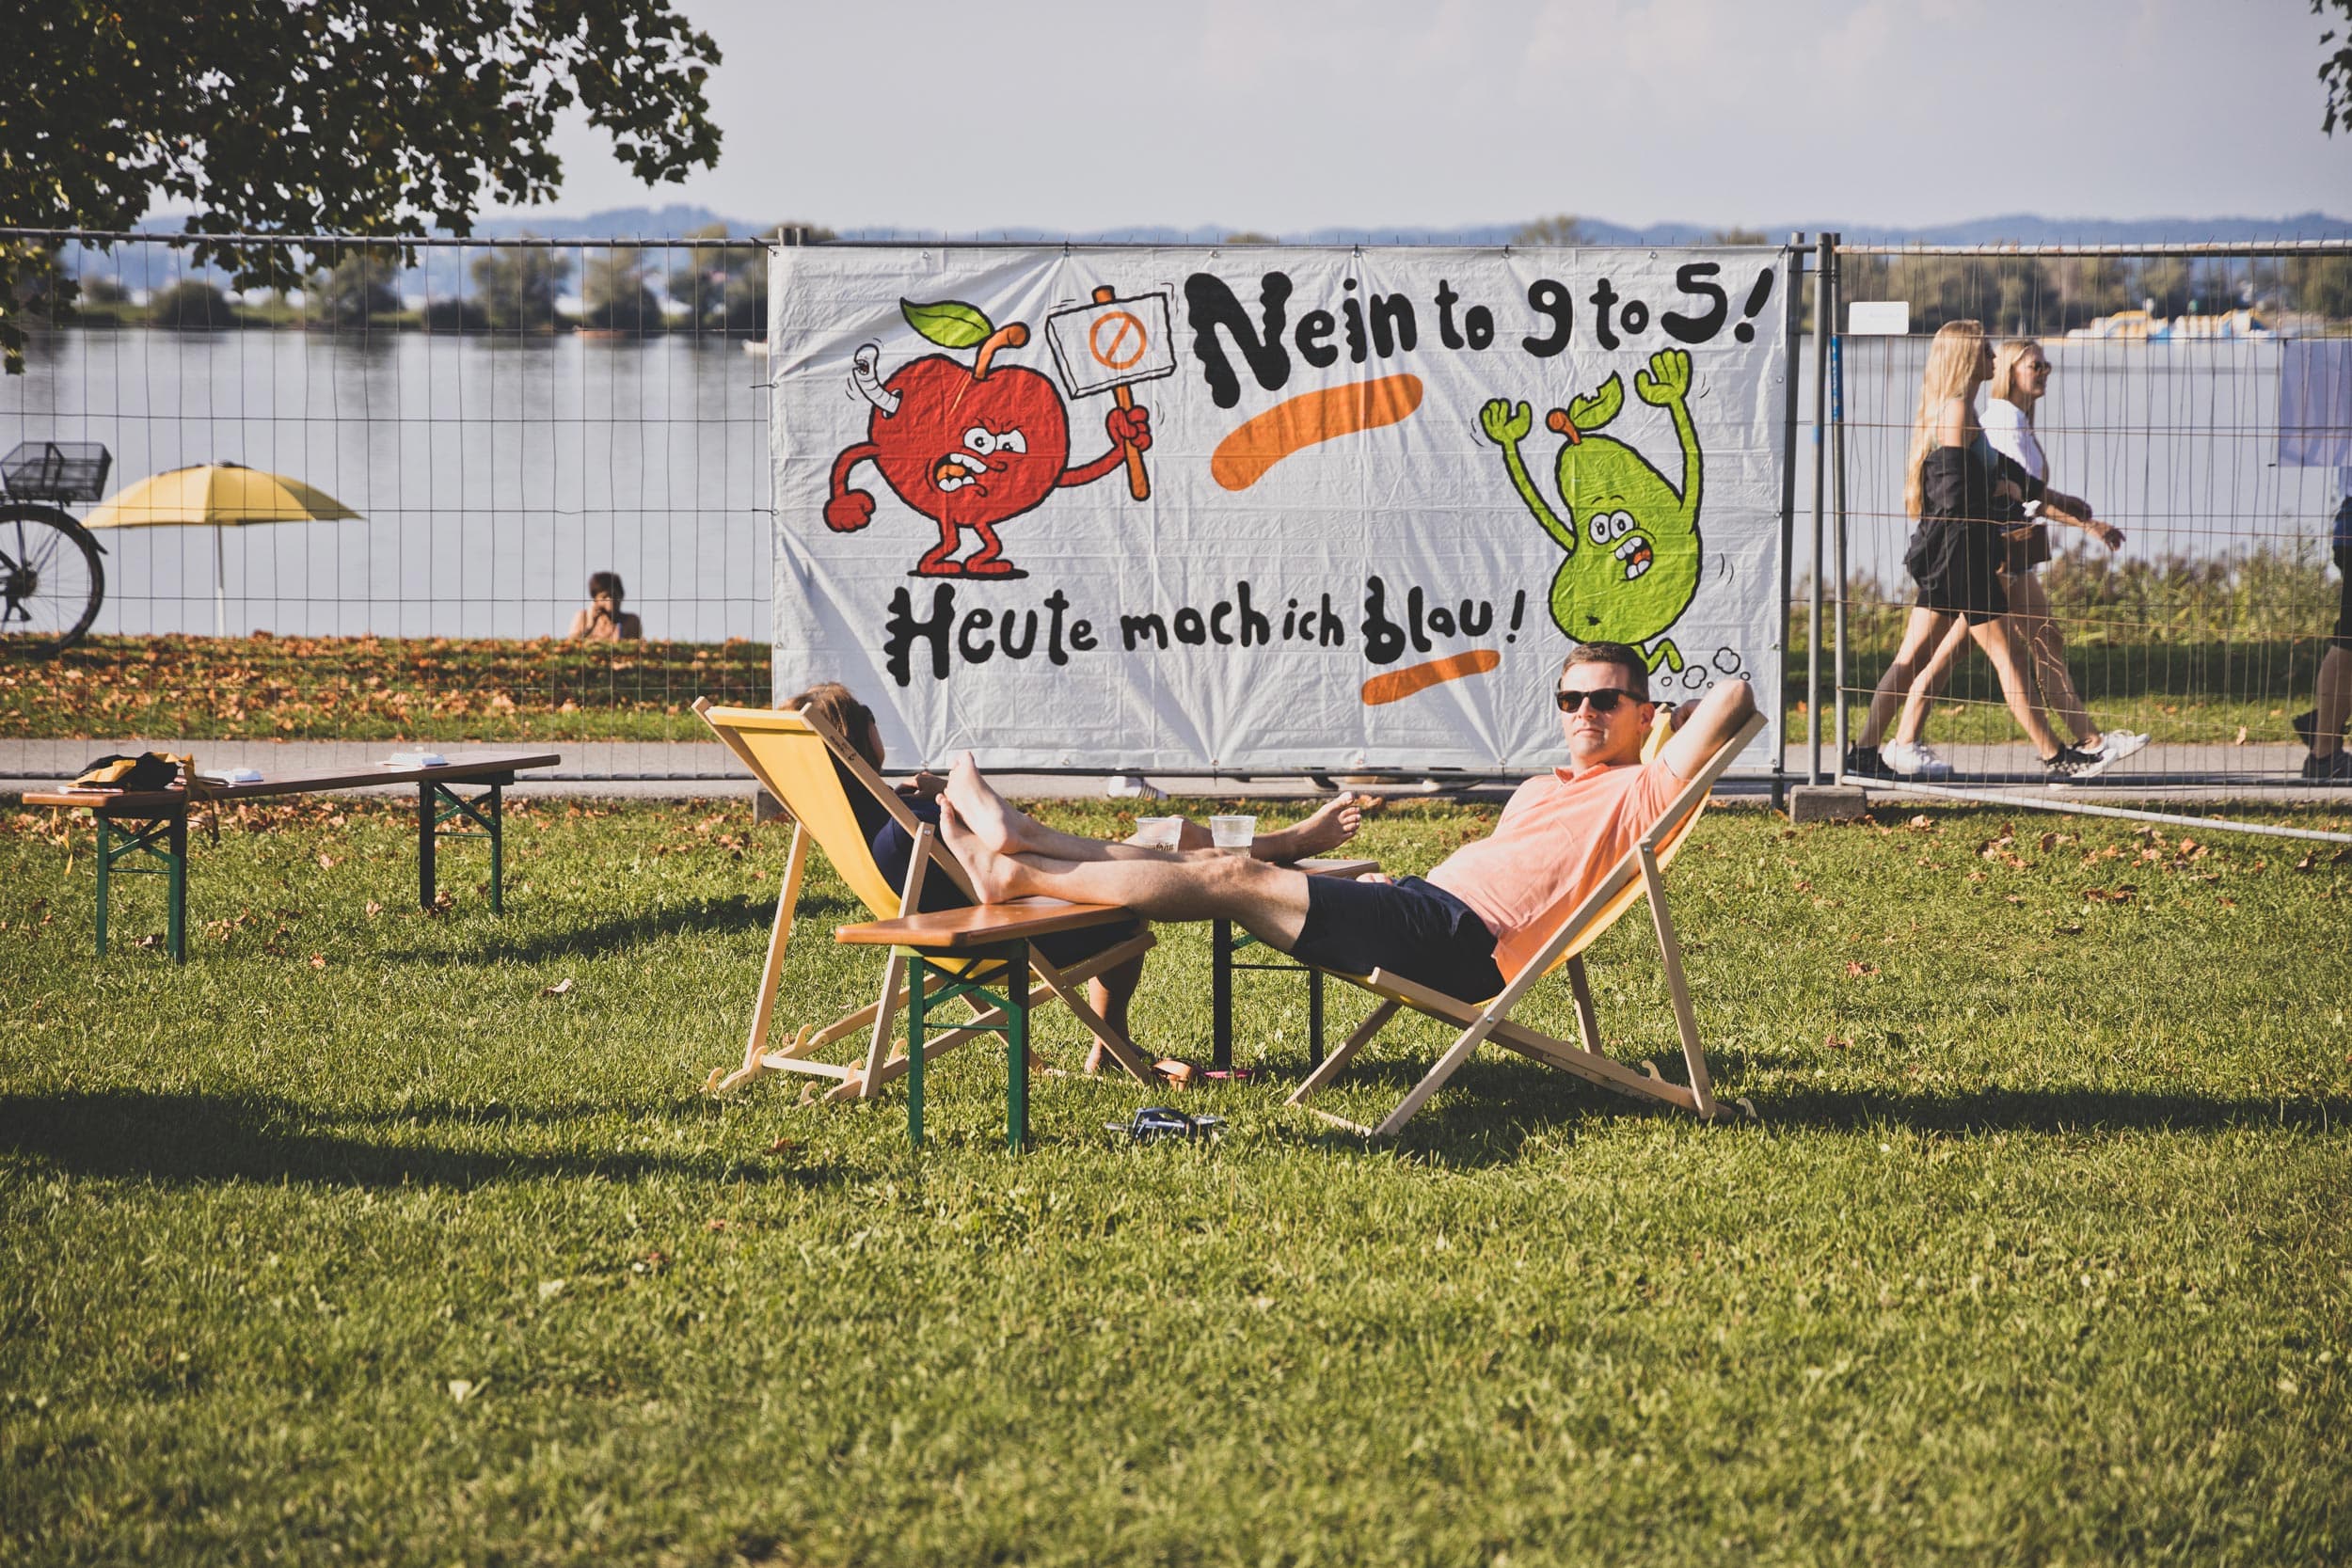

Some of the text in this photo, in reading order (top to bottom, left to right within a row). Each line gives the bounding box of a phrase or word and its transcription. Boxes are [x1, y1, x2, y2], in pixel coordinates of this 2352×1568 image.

[1184, 271, 1418, 409] Nein
[1434, 278, 1495, 351] to
[1521, 278, 1573, 358] 9
[1589, 277, 1650, 352] to
[883, 582, 1099, 689] Heute
[1120, 580, 1271, 652] mach
[1282, 593, 1345, 647] ich
